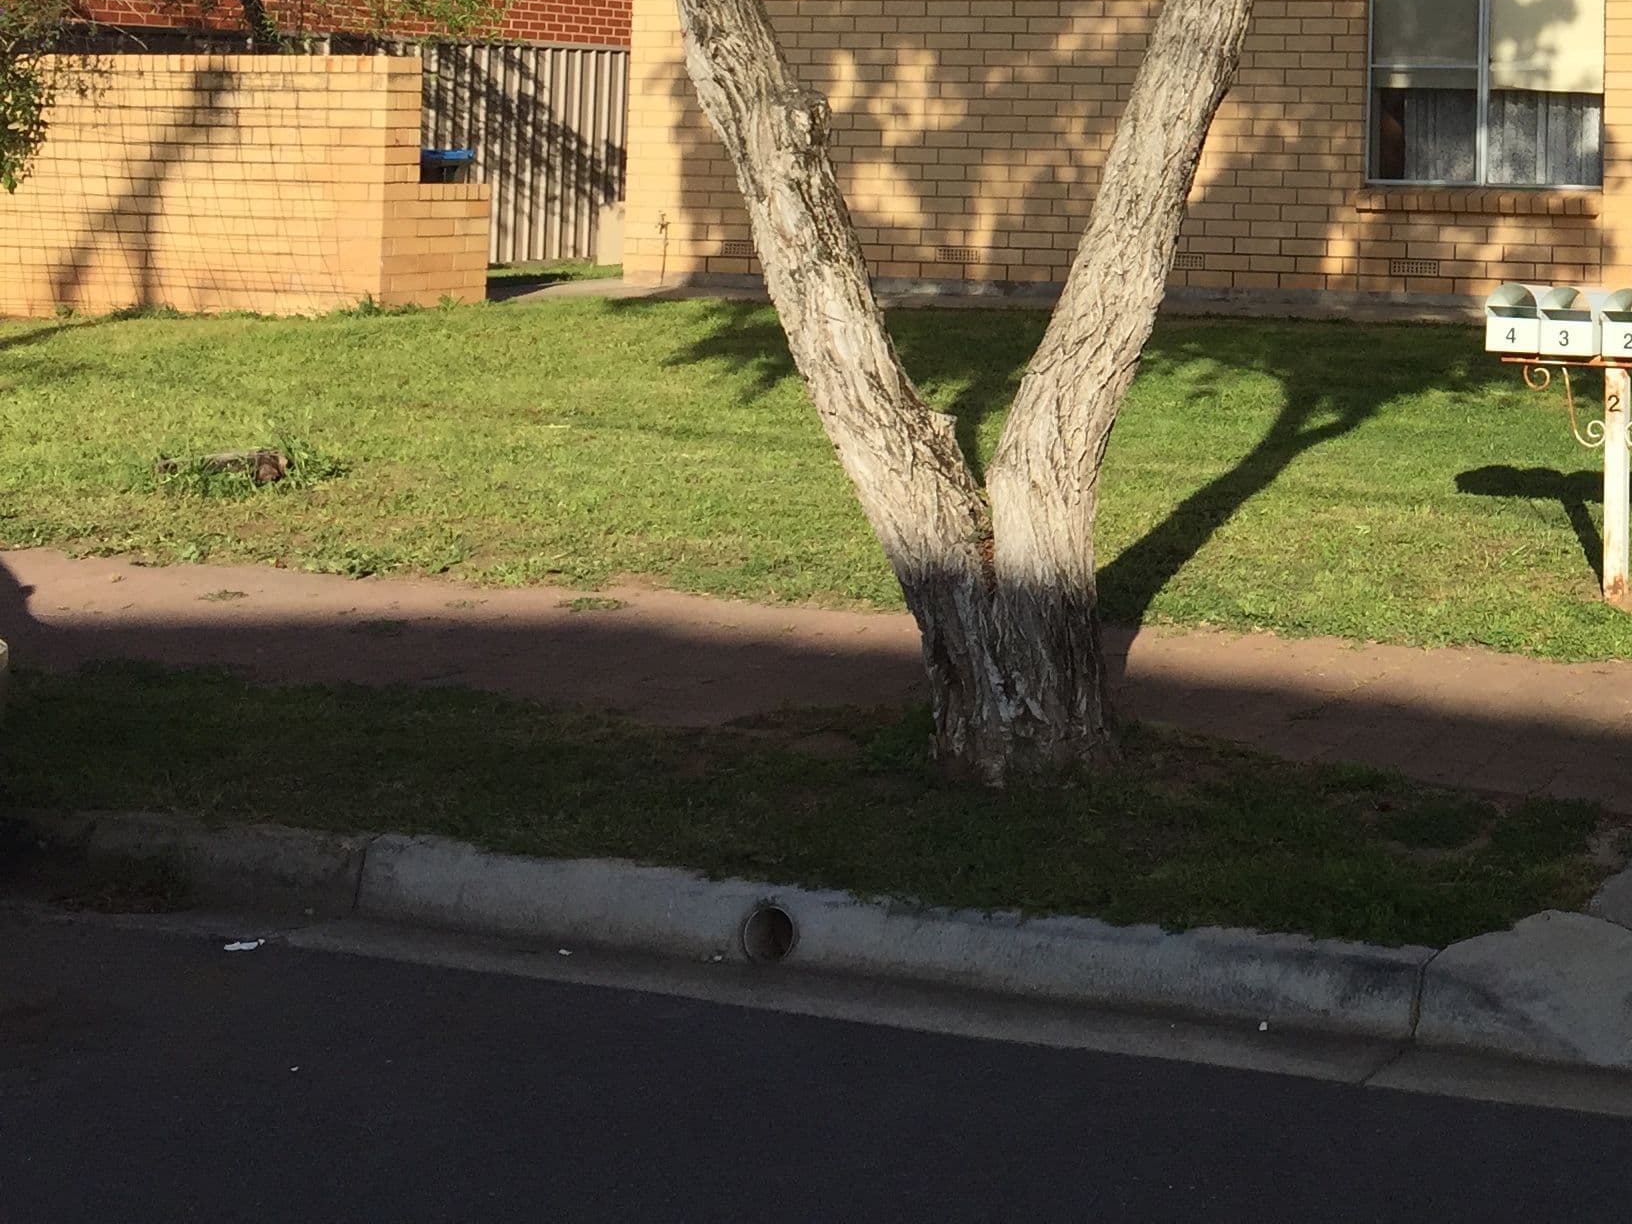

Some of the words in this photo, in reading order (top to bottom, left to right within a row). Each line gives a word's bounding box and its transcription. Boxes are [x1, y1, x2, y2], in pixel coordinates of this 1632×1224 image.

[1505, 327, 1516, 343] 4
[1558, 330, 1569, 346] 3
[1607, 394, 1621, 412] 2
